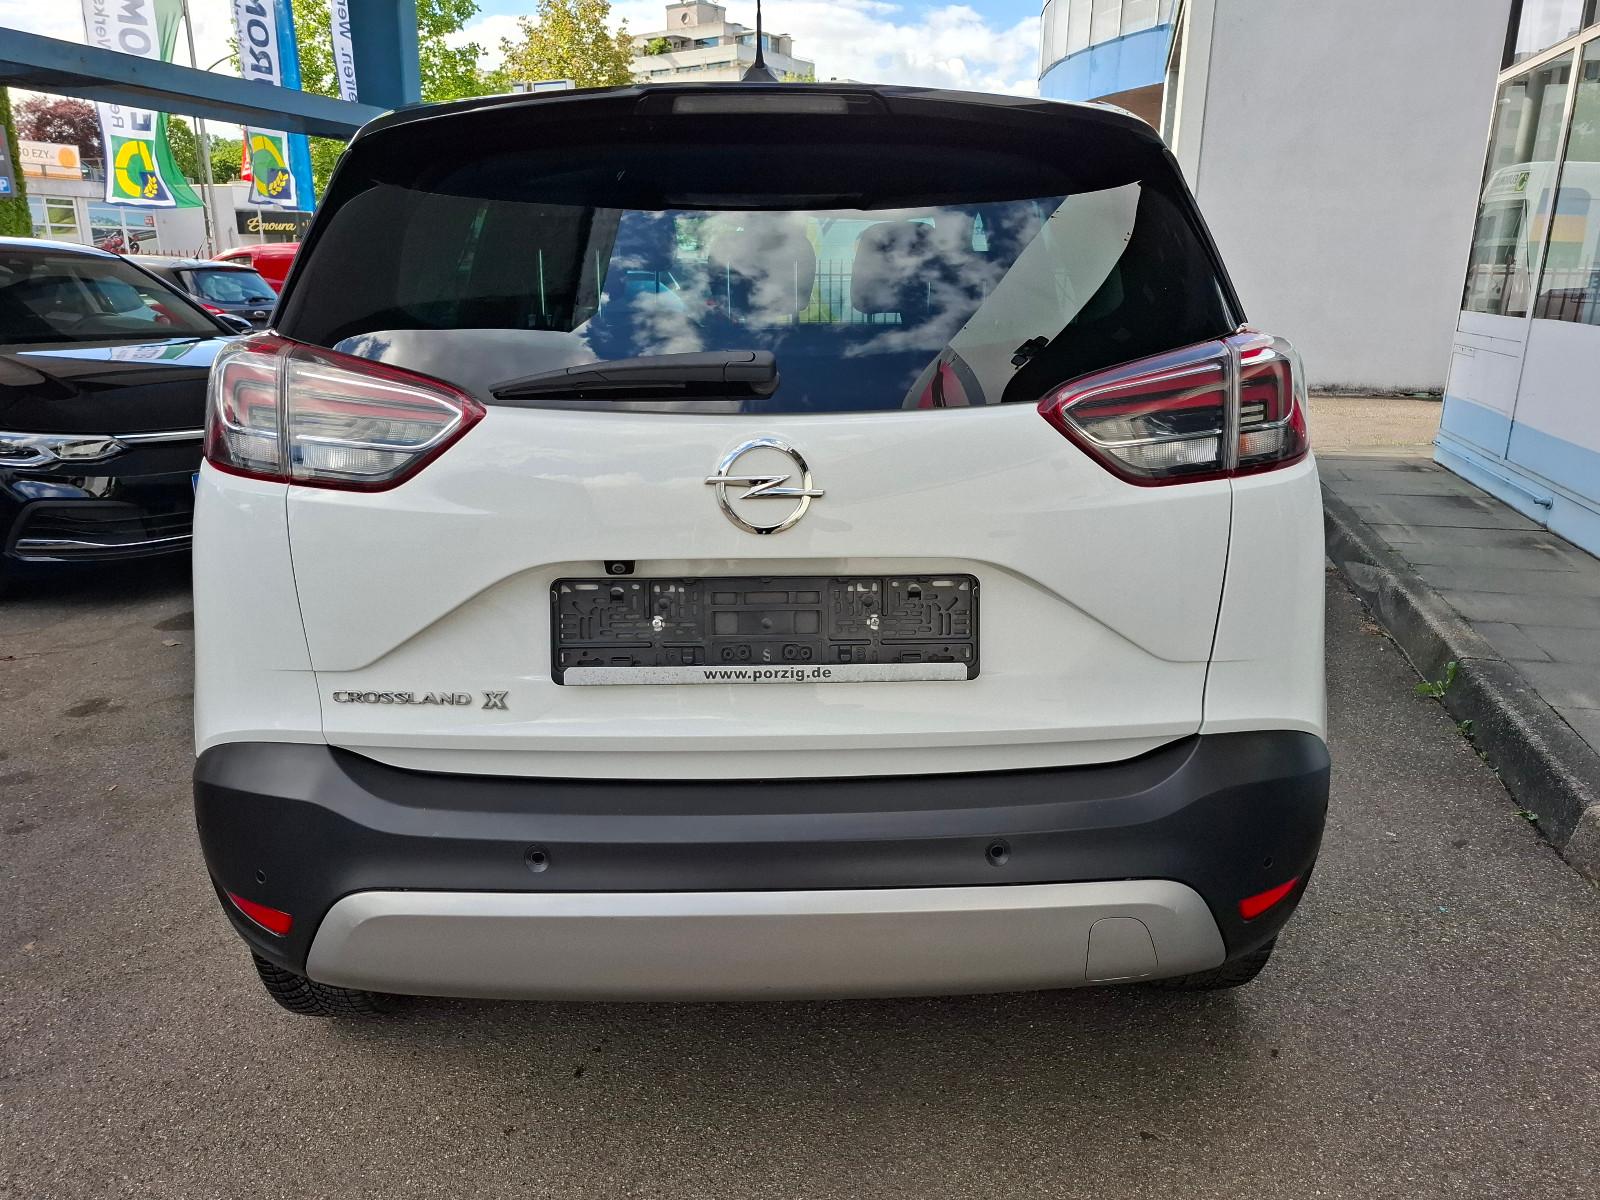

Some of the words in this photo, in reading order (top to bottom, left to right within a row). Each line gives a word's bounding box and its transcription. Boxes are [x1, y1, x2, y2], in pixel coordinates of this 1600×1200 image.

[703, 667, 832, 681] www.porzig.de
[333, 690, 473, 706] CROSSLAND
[481, 690, 509, 710] X
